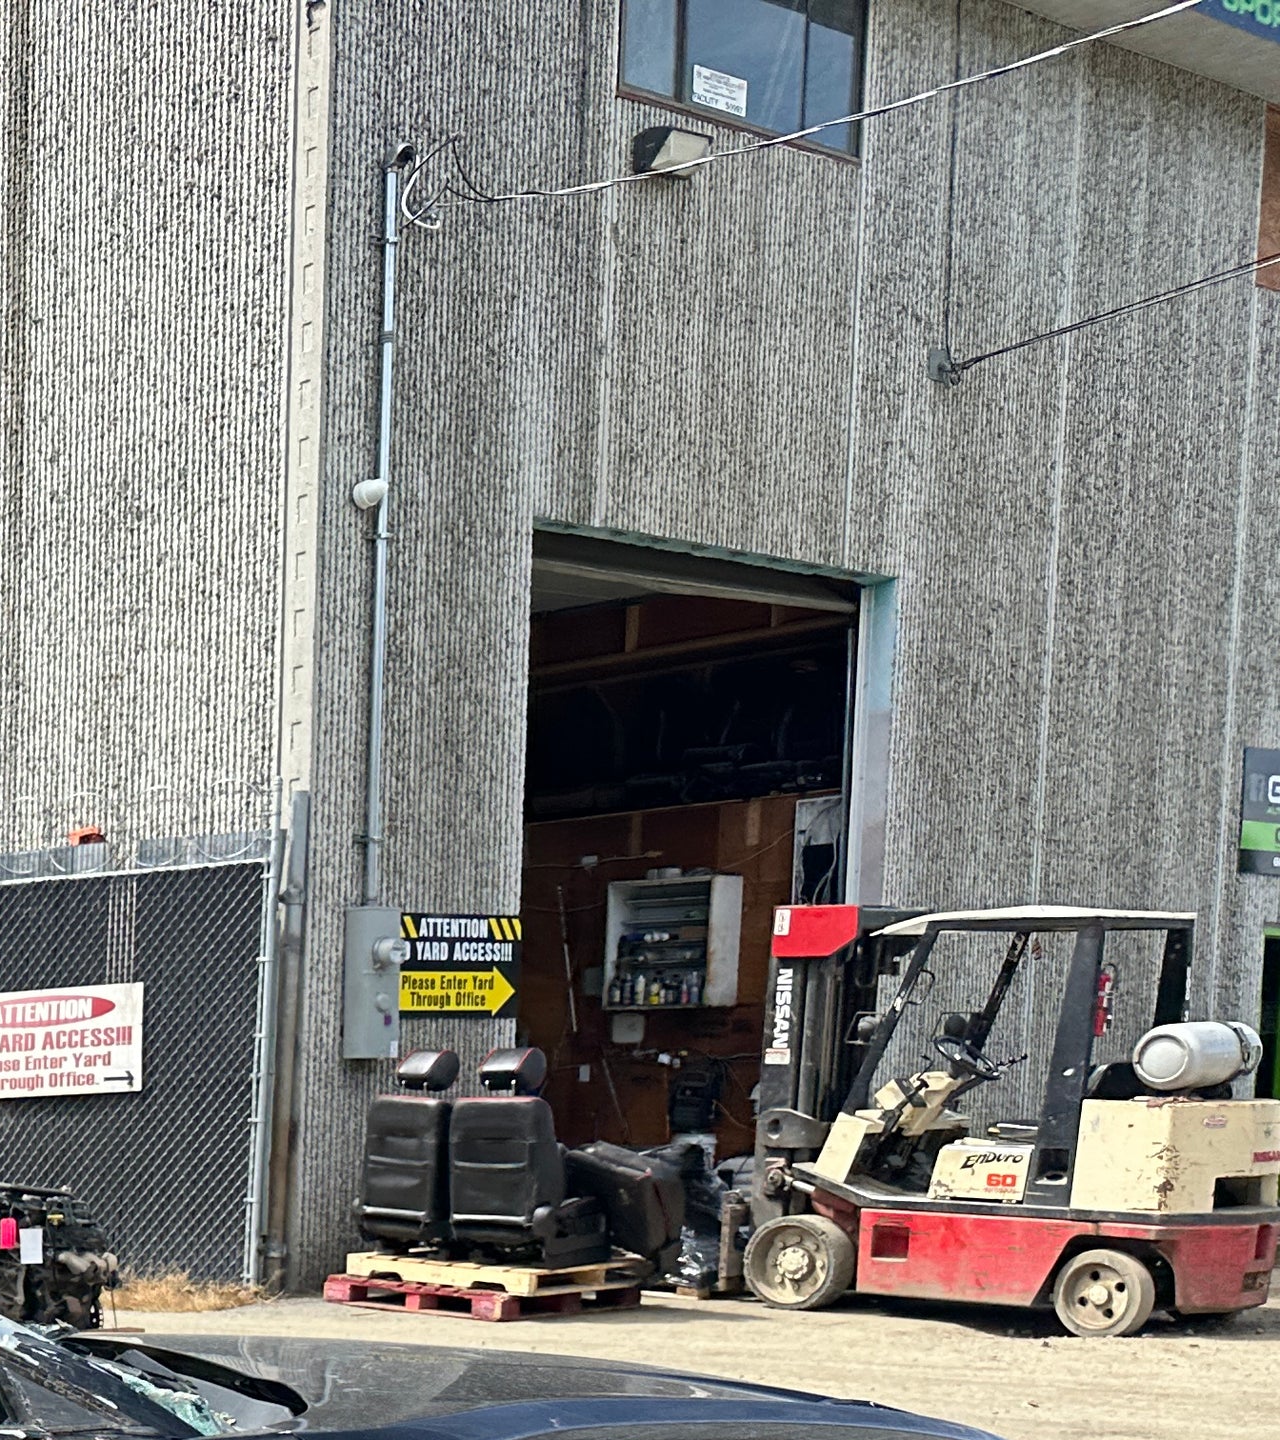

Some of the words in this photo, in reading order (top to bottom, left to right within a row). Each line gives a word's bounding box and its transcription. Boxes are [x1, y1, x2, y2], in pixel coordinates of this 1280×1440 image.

[419, 918, 488, 939] ATTENTION
[416, 941, 449, 961] YARD
[453, 942, 512, 962] ACCESS!!!
[401, 975, 436, 990] Please
[440, 975, 468, 990] Enter
[472, 975, 495, 990] Yard
[410, 992, 451, 1008] Through
[455, 992, 486, 1007] Office
[772, 968, 793, 1048] NISSAN
[41, 1026, 133, 1050] ACCESS!!!
[25, 1055, 67, 1071] Enter
[72, 1051, 112, 1068] Yard
[986, 1173, 1017, 1187] 60
